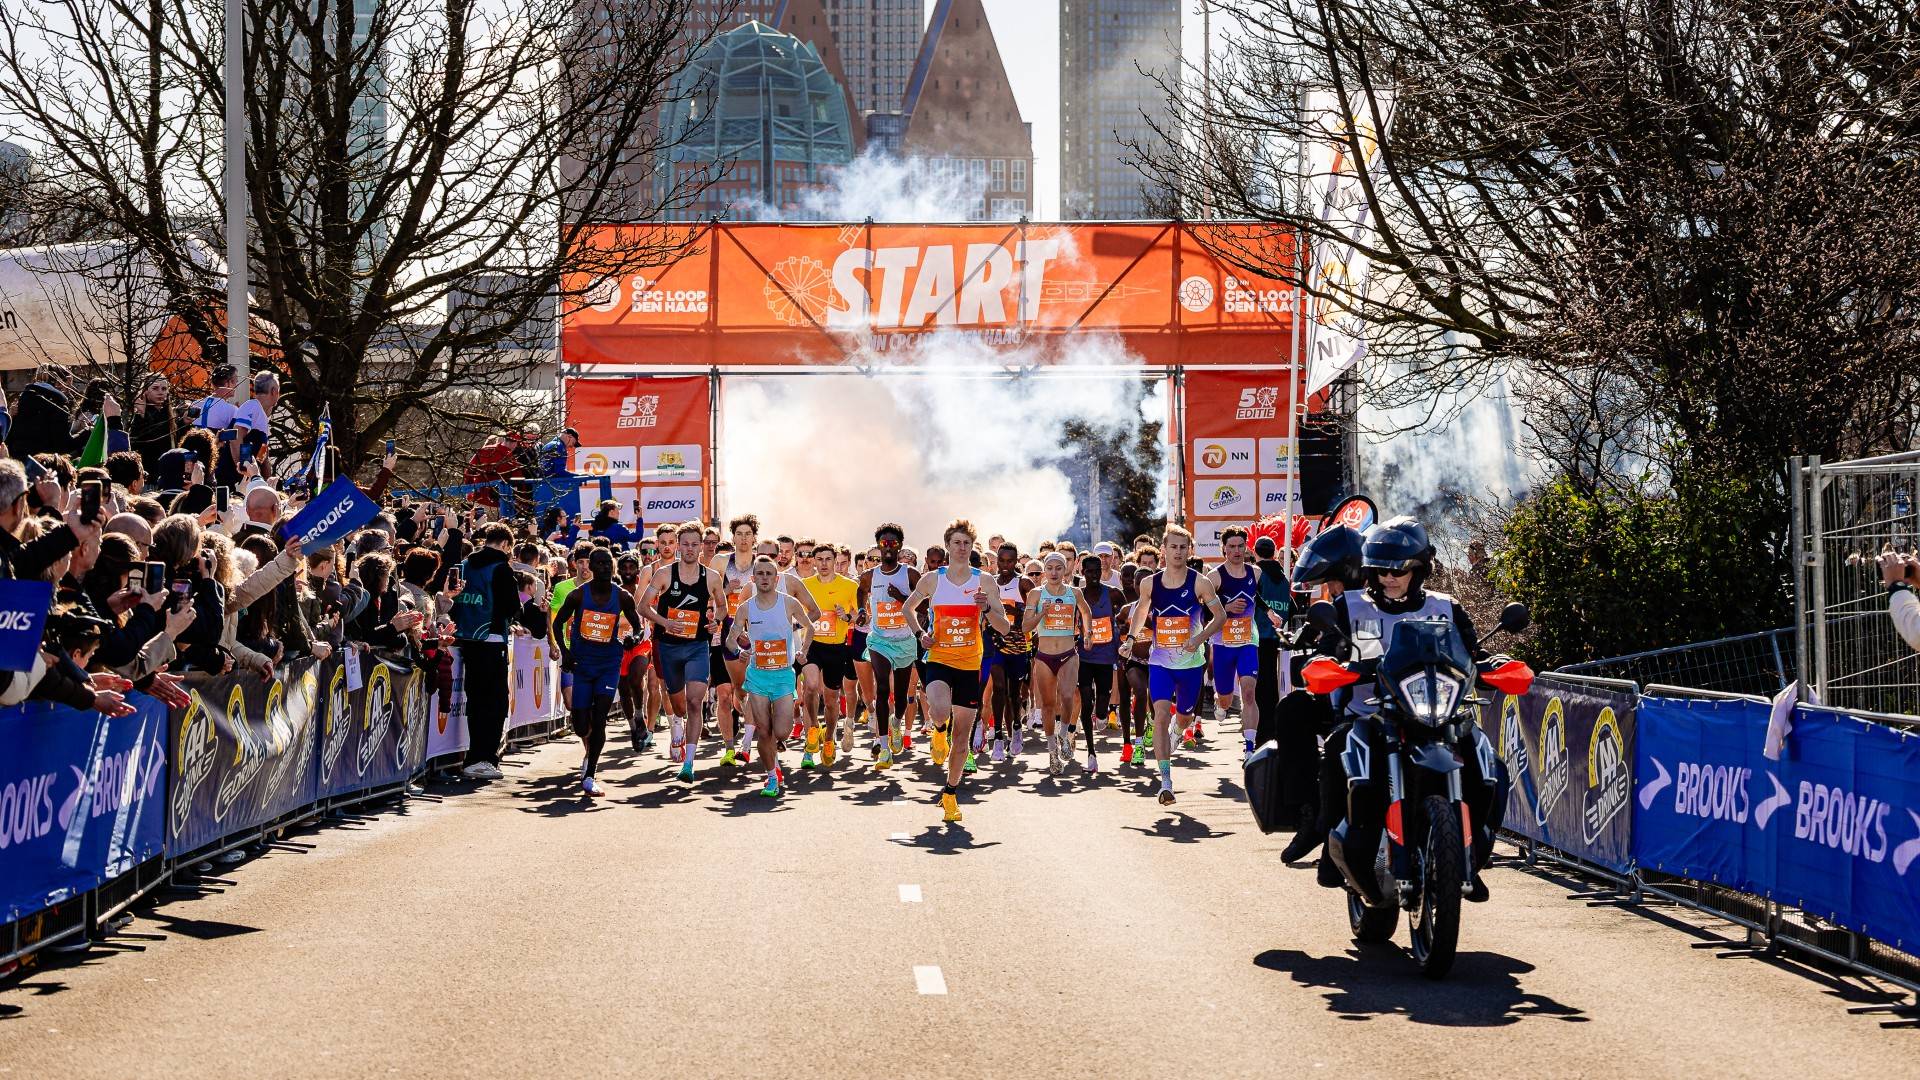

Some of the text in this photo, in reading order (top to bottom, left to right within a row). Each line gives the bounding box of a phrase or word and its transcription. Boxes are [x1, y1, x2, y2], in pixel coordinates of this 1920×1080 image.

[826, 239, 1059, 328] START
[631, 290, 707, 302] CPC LOOP
[1224, 289, 1256, 301] CPC
[631, 301, 708, 313] DEN HAAG
[1224, 301, 1255, 313] DEN
[1236, 408, 1275, 419] EDITIE
[618, 416, 656, 427] EDITIE
[1231, 452, 1249, 461] NN
[612, 460, 631, 469] NN
[646, 499, 696, 510] BROOKS
[298, 494, 354, 544] BROOKS
[458, 592, 483, 606] EDIA
[1598, 736, 1618, 791] AA
[1675, 761, 1752, 824] BROOKS
[0, 771, 57, 849] OOKS
[1597, 785, 1622, 824] DRINK
[1795, 780, 1890, 863] BROOKS
